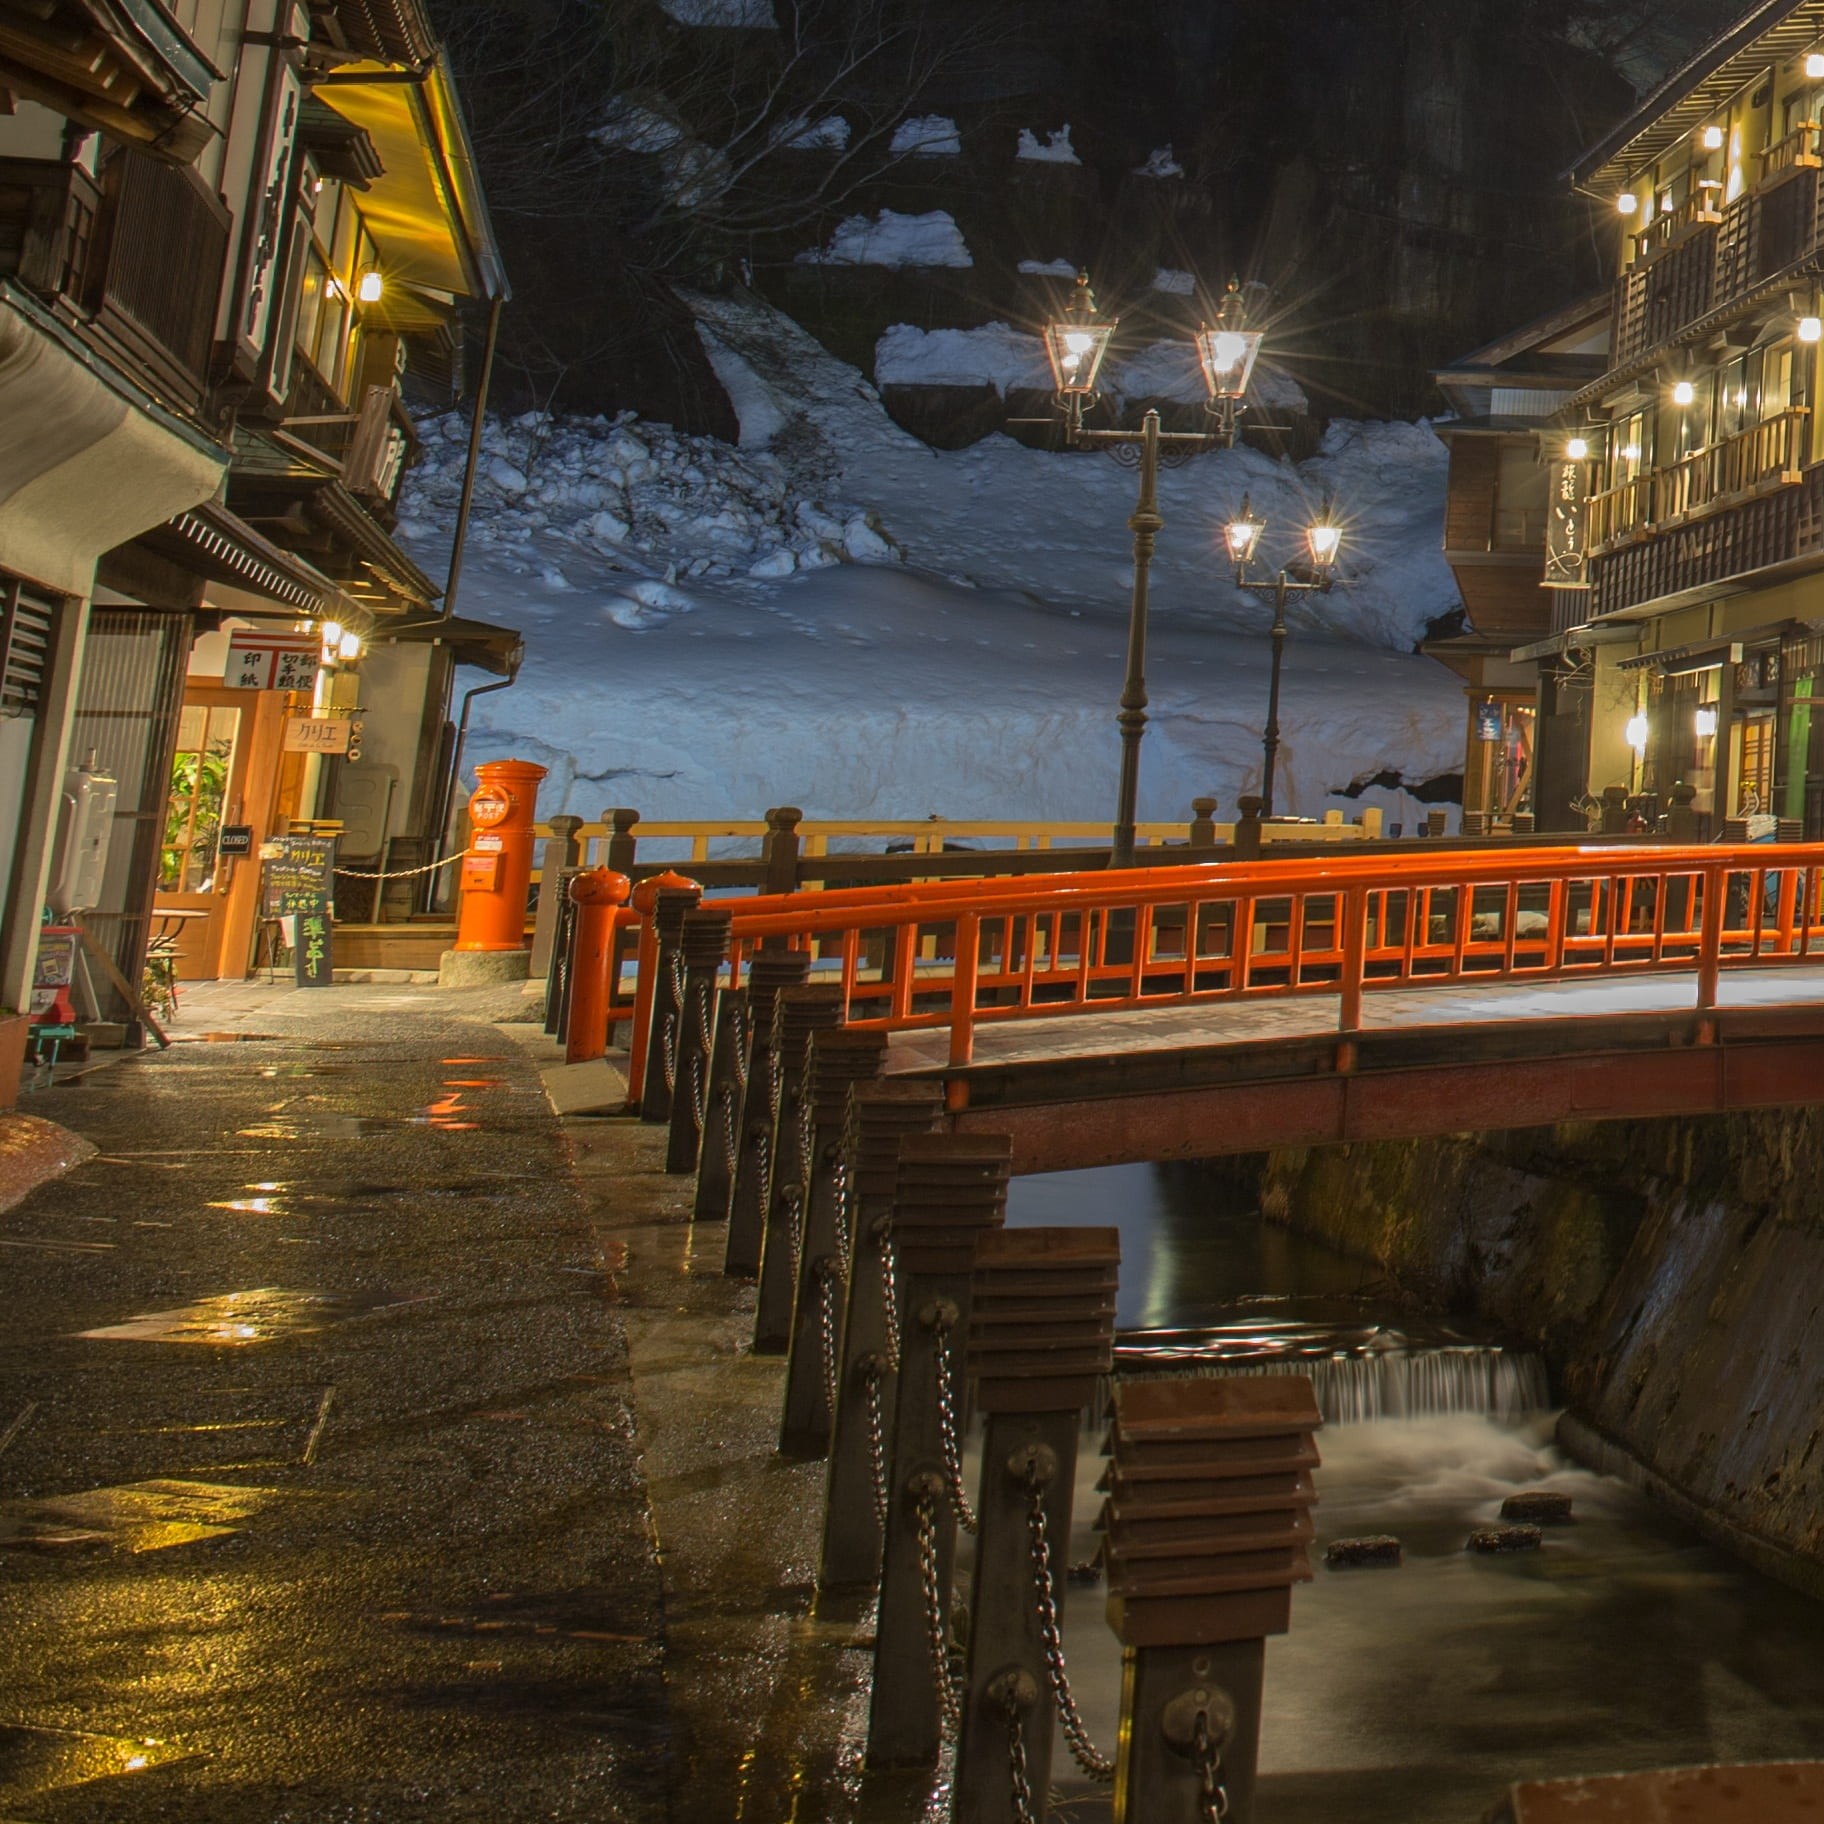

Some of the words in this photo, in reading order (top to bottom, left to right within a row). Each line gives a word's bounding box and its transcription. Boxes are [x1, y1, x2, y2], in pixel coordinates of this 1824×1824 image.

[240, 652, 262, 687] 印紙
[277, 653, 299, 688] 切手類
[297, 652, 318, 689] 郵便
[296, 722, 338, 742] クリエ
[476, 812, 500, 820] POST
[222, 833, 249, 845] CLOSED
[290, 848, 327, 867] クリエ
